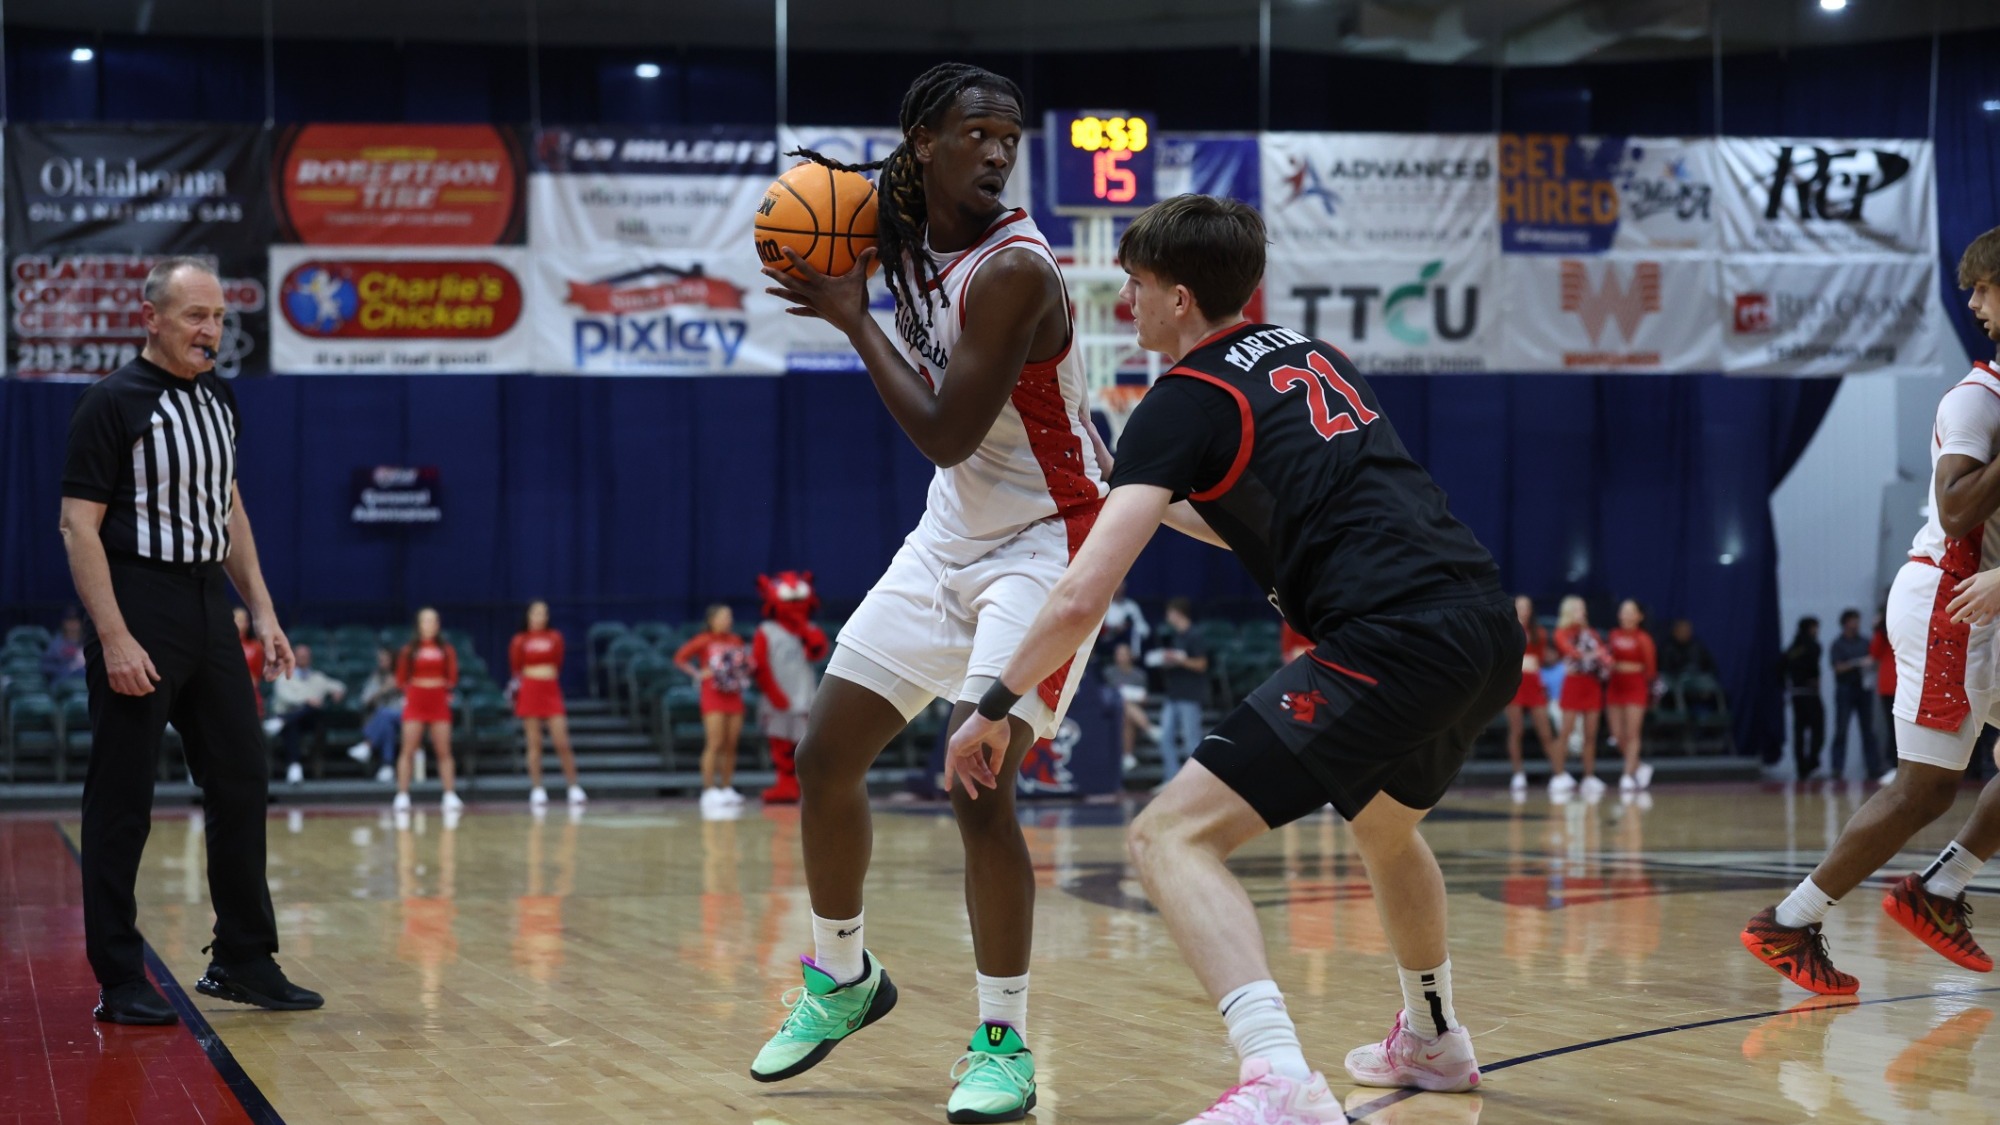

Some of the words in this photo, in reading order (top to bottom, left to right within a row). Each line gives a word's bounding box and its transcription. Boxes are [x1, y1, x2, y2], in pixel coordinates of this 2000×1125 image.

[40, 156, 226, 198] Oklahoma
[296, 160, 499, 184] ROBERTSON
[1093, 149, 1137, 202] 15
[1331, 157, 1491, 179] ADVANCED
[1500, 133, 1569, 178] GET
[29, 203, 65, 222] OIL
[199, 203, 243, 222] GAS
[361, 187, 438, 209] TIRE
[1500, 180, 1620, 225] HIRED
[358, 271, 503, 300] Charlie's
[359, 301, 495, 330] Chicken
[1292, 284, 1478, 344] TTCU
[573, 312, 748, 367] pixley
[1225, 328, 1312, 372] MARTIN
[1269, 350, 1379, 442] 21
